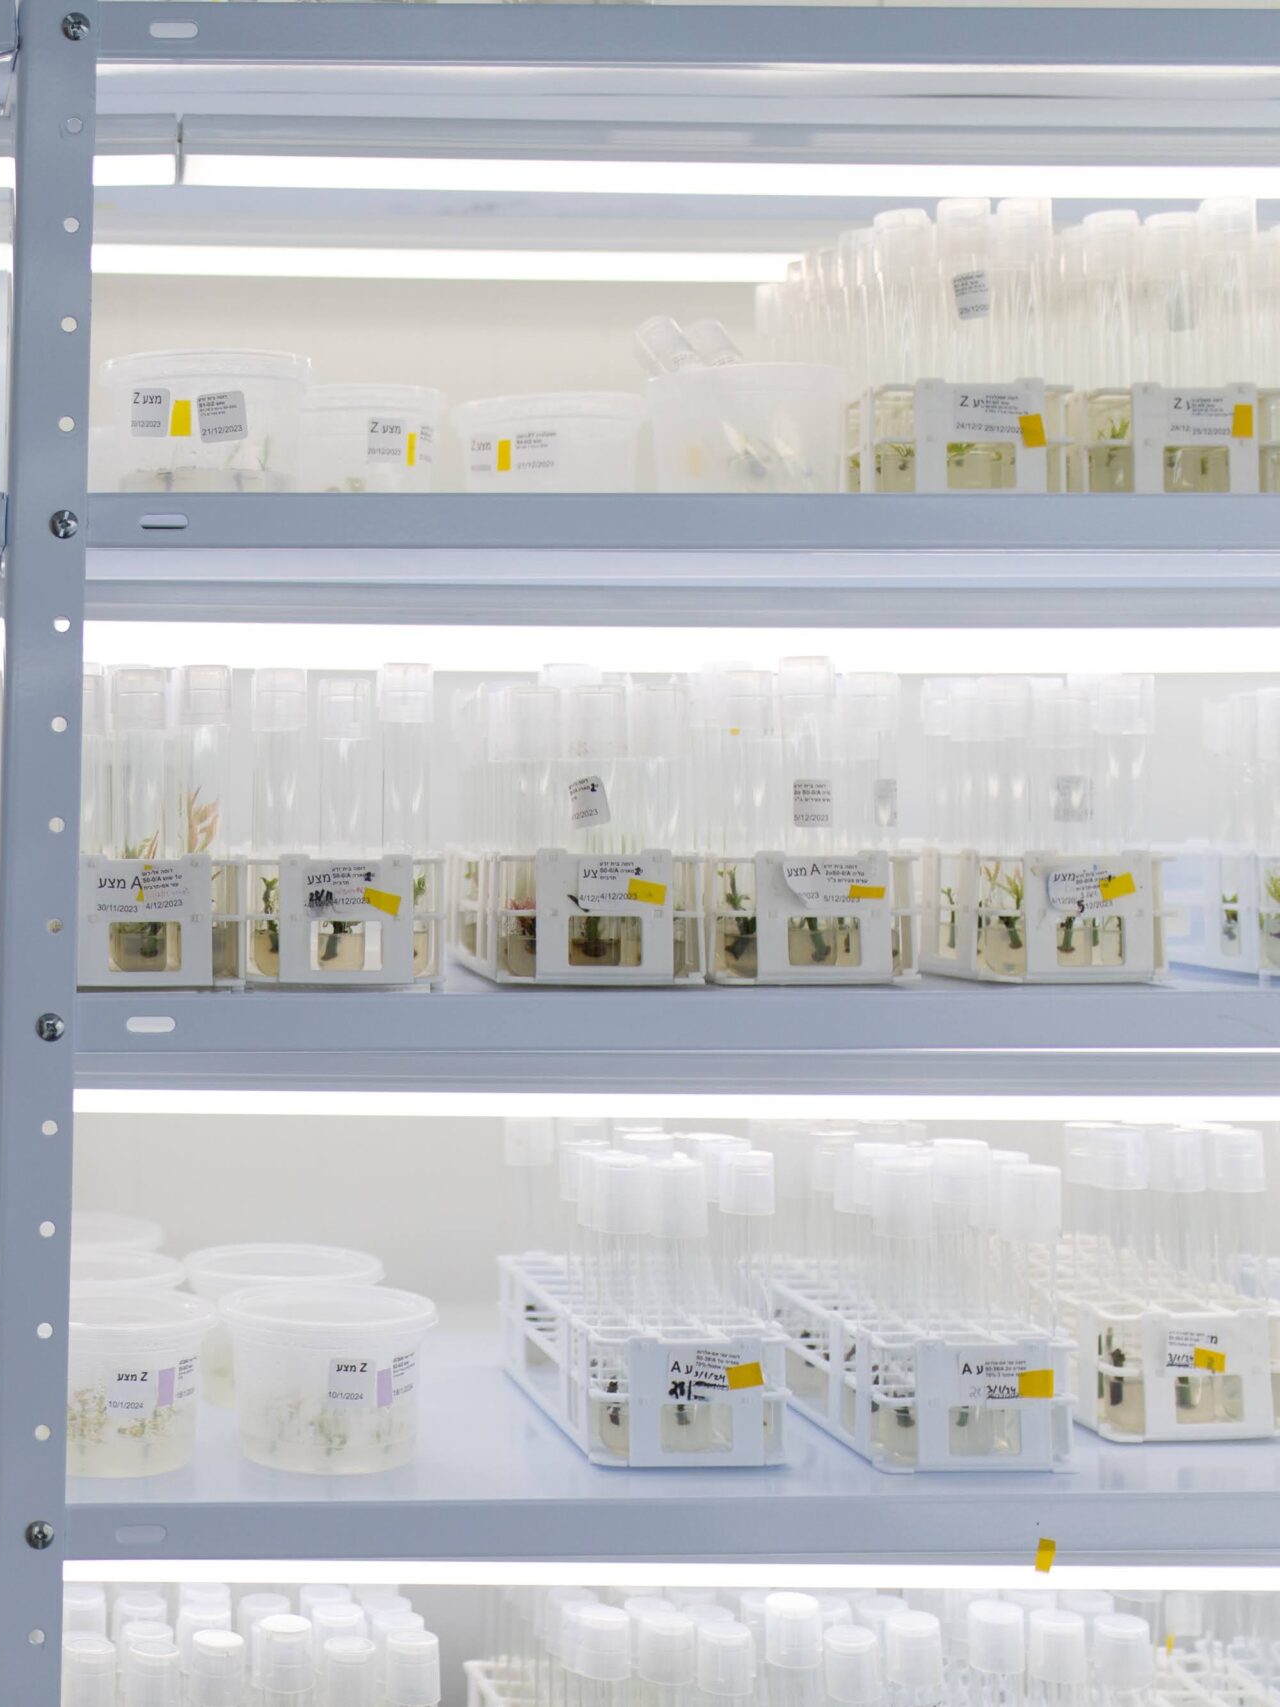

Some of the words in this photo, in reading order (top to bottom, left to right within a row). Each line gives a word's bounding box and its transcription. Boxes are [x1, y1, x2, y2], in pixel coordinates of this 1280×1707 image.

[133, 392, 140, 404] Z
[144, 394, 162, 405] מצע
[960, 395, 969, 407] Z
[1173, 398, 1182, 409] Z
[201, 425, 243, 436] 21/12/2023
[370, 421, 379, 433] Z
[583, 868, 598, 878] צע
[787, 867, 807, 879] מצע
[810, 863, 821, 874] A
[99, 877, 126, 890] מצע
[130, 876, 142, 890] A
[307, 873, 331, 885] מצע
[1053, 873, 1076, 882] מצע
[97, 903, 138, 912] 30/11/2023
[145, 899, 183, 910] 4/12/2023
[336, 1363, 357, 1373] מצע
[359, 1362, 368, 1373] Z
[671, 1360, 682, 1373] A
[961, 1363, 971, 1375] A
[116, 1371, 138, 1382] מצע
[140, 1371, 148, 1382] Z
[328, 1391, 364, 1400] 10/1/2024
[108, 1401, 144, 1410] 10/1/2024
